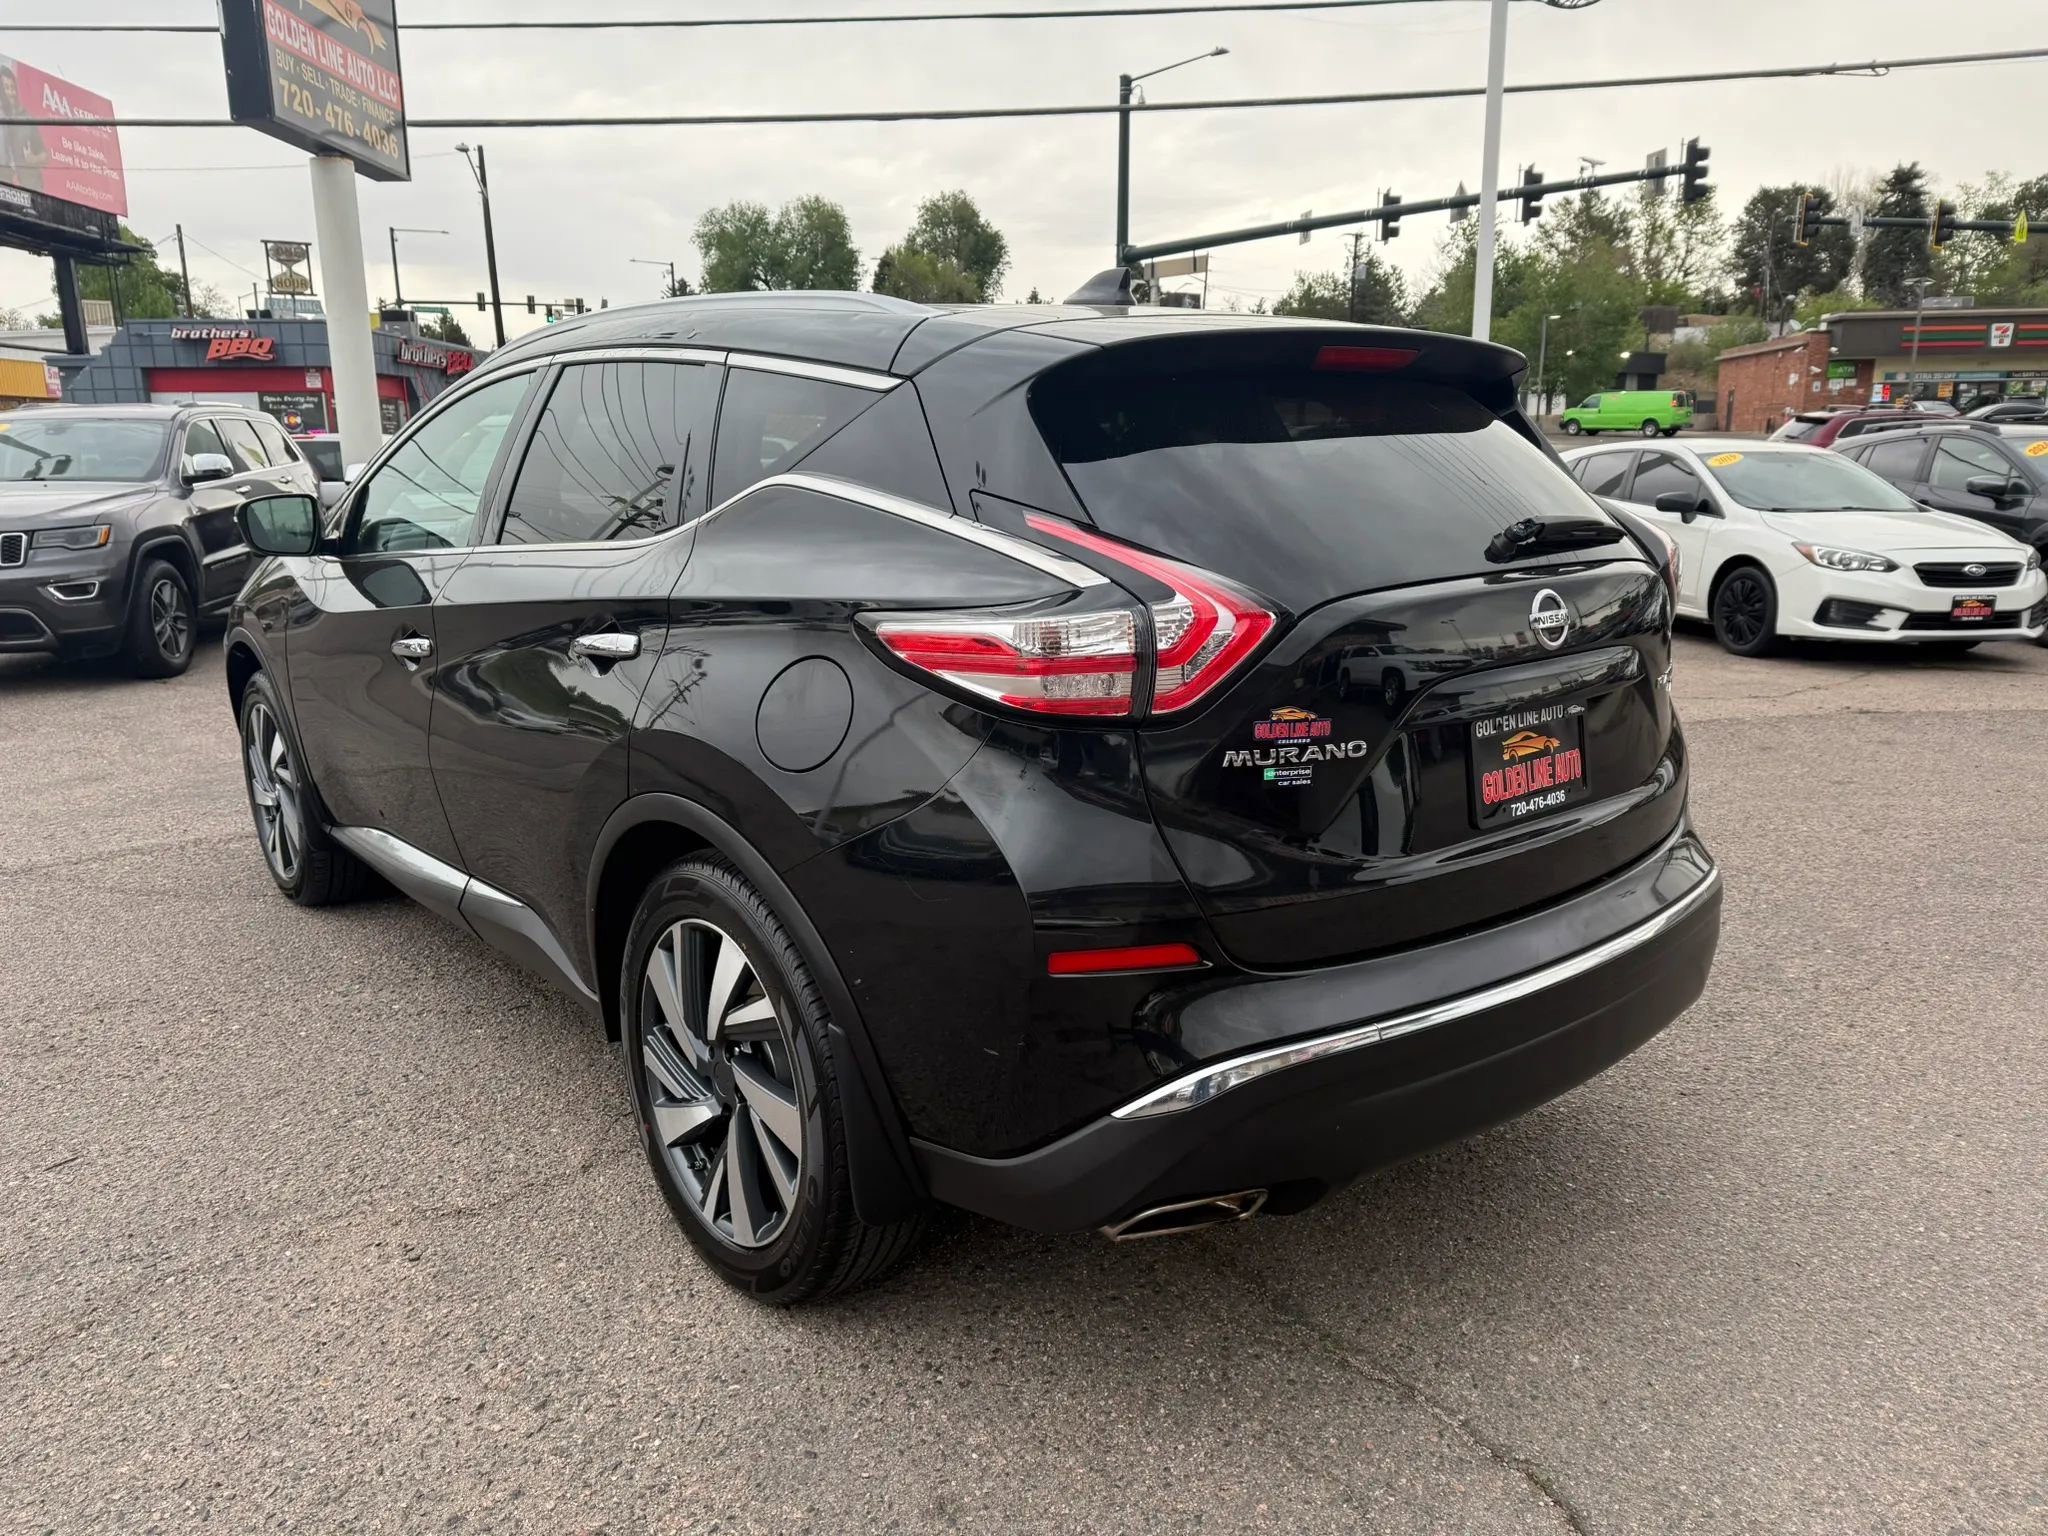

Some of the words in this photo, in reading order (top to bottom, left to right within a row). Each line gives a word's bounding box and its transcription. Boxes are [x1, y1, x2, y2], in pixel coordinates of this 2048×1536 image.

[266, 5, 316, 60] GOLDEN
[317, 35, 345, 75] LINE
[347, 52, 375, 90] AUTO
[376, 71, 397, 103] LLC
[275, 48, 295, 74] BUY
[301, 63, 325, 90] SELL
[329, 78, 358, 107] TRADE
[362, 97, 395, 126] FINANCE
[42, 83, 72, 118] AAA
[62, 136, 72, 150] Be
[51, 148, 73, 166] Leave
[73, 154, 80, 168] it
[80, 158, 89, 169] to
[276, 278, 307, 288] HOUR
[171, 328, 250, 338] brothers
[207, 338, 274, 360] BBQ
[401, 343, 447, 366] brothers
[1538, 612, 1570, 625] NISSAN
[1518, 711, 1539, 727] LINE
[1541, 704, 1564, 722] AUTO
[1254, 722, 1289, 739] GOLDEN
[1290, 722, 1309, 737] LINE
[1310, 720, 1332, 736] AUTO
[1222, 740, 1368, 768] MURANO
[1266, 768, 1310, 777] enterprise
[1482, 762, 1527, 805] GOLDEN
[1527, 756, 1553, 791] LINE
[1555, 748, 1582, 784] AUTO
[1511, 789, 1566, 817] 720-476-4036
